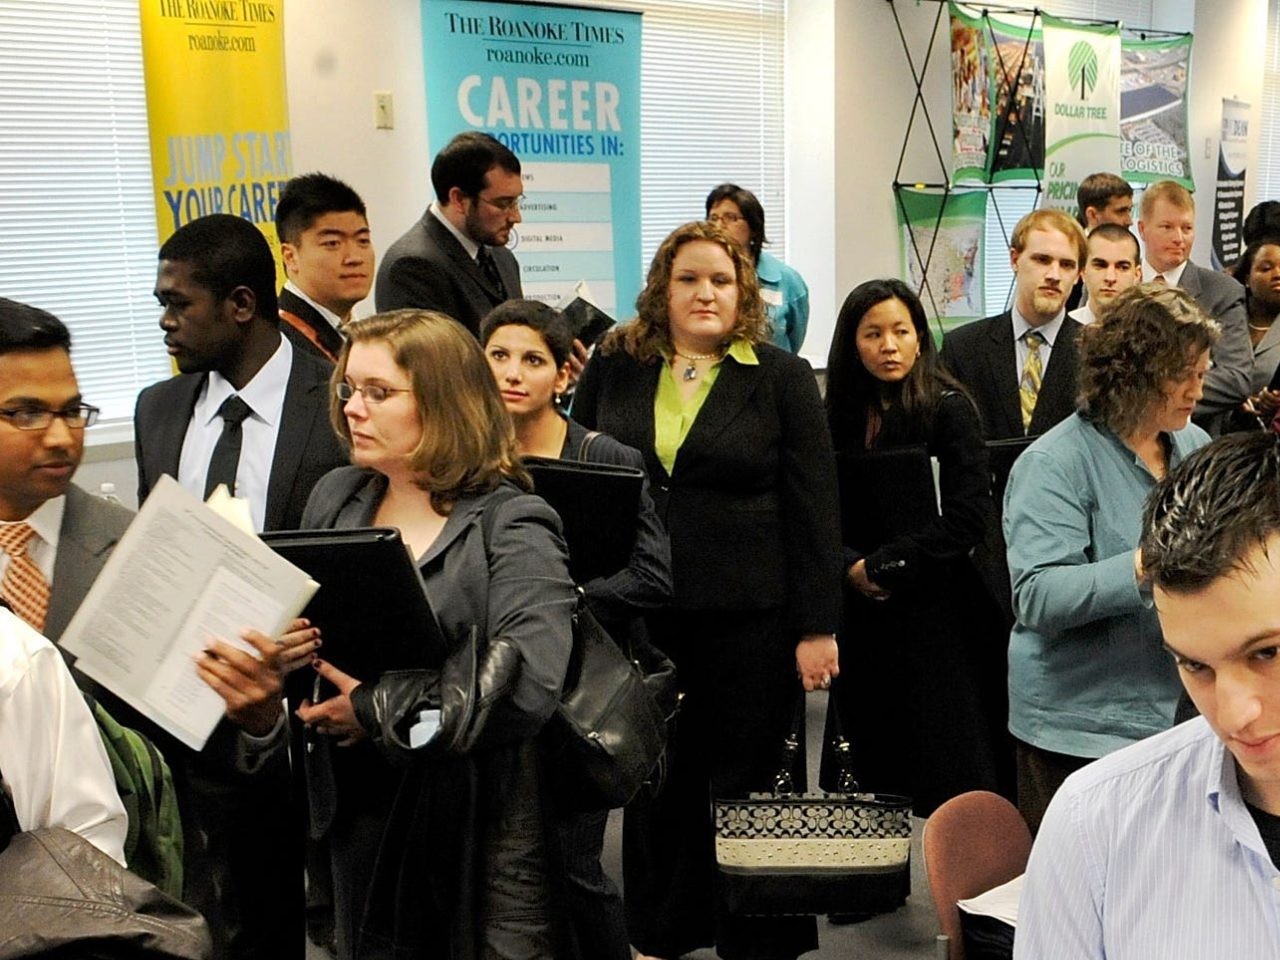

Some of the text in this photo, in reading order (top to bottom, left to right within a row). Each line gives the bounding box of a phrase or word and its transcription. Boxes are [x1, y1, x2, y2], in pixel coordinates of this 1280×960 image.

[160, 0, 276, 23] THE ROANOKE TIMES
[445, 13, 625, 45] THE ROANOKE TIMES
[188, 30, 256, 52] roanoke.com
[487, 47, 590, 68] roanoke.com
[457, 75, 622, 132] CAREER
[1054, 103, 1107, 120] DOLLAR TREE
[601, 135, 625, 157] IN:
[164, 133, 226, 187] JUMP
